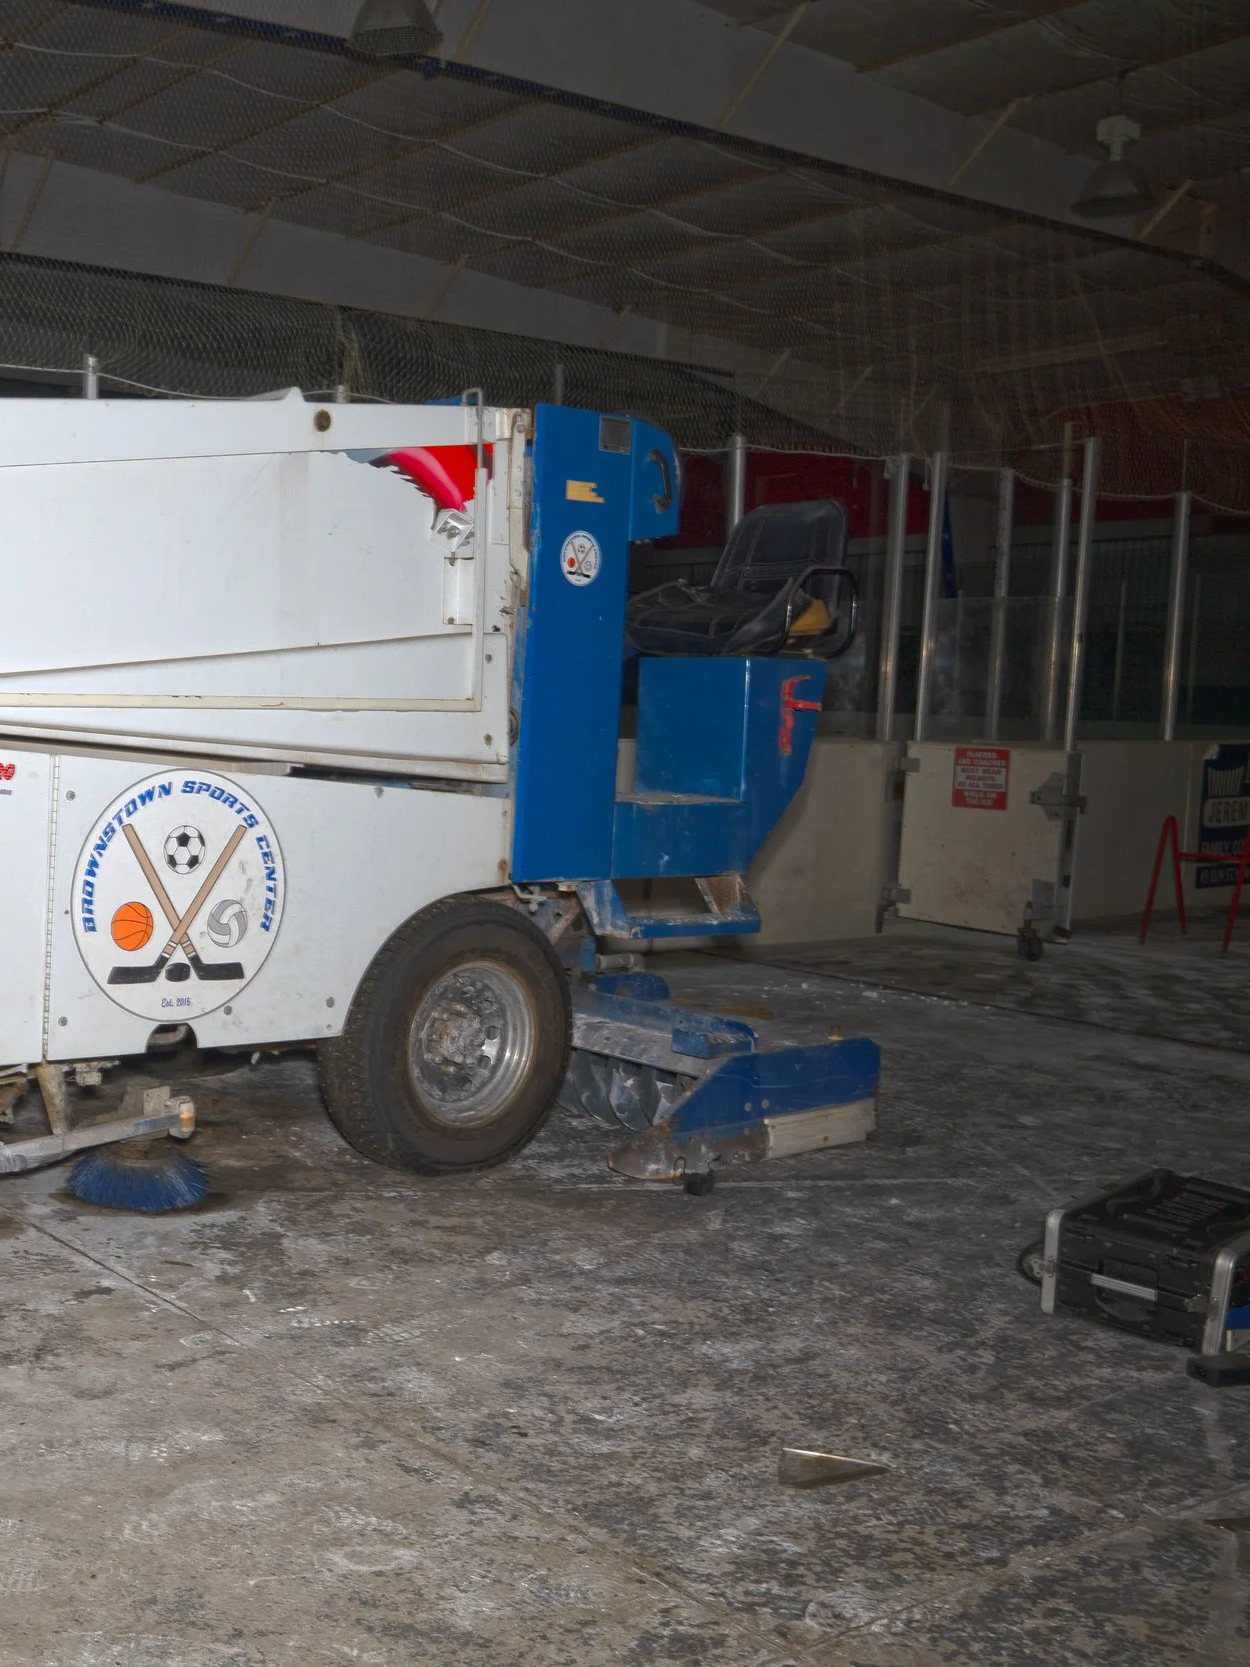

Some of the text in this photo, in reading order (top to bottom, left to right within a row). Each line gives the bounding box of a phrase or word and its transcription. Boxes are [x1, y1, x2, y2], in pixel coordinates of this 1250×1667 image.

[81, 780, 278, 933] BROWNSTOWN SPORTS CENTER
[161, 997, 191, 1007] Est. 2015
